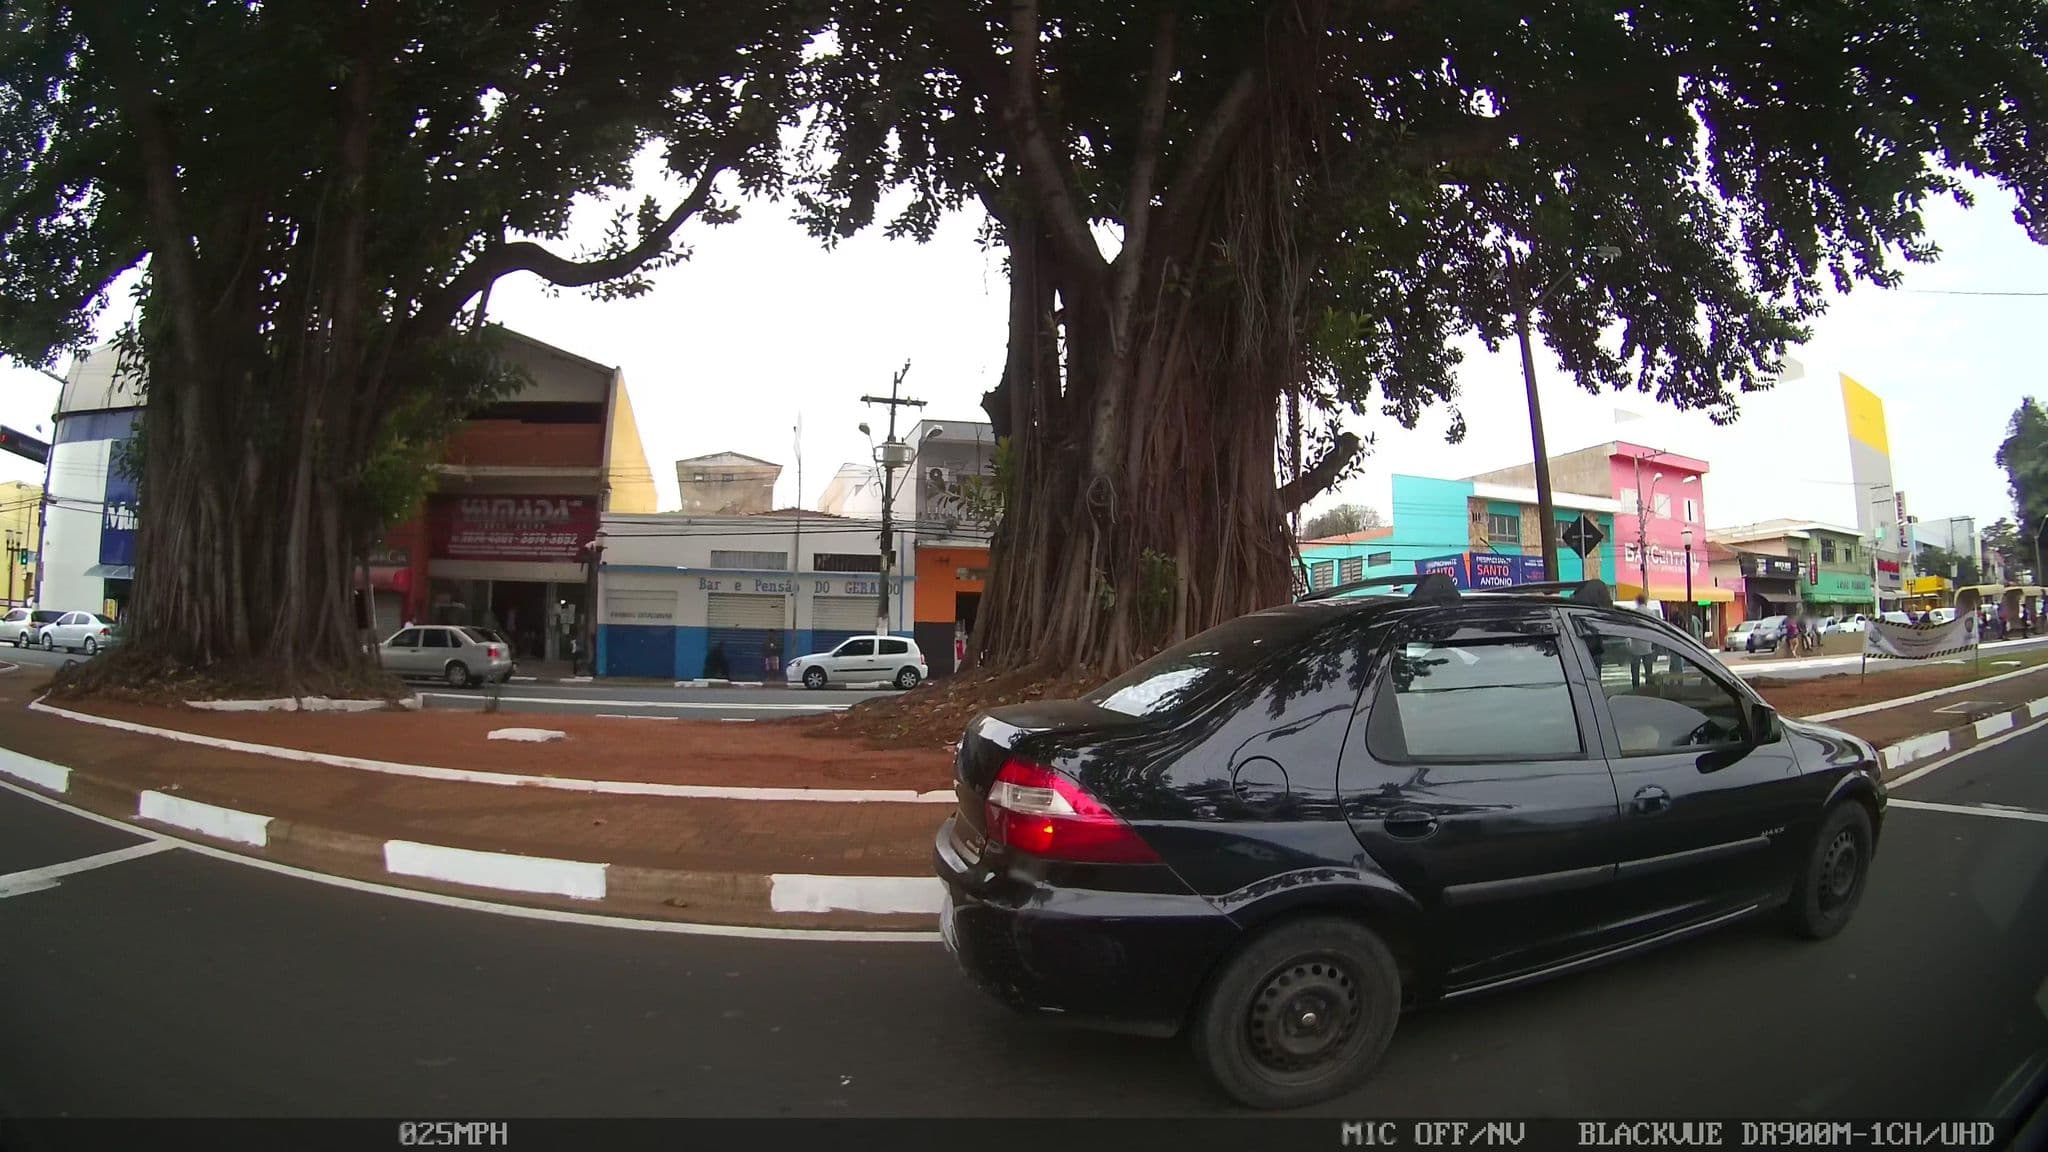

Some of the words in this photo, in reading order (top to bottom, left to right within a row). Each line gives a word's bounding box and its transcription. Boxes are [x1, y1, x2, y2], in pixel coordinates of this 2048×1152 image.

[1477, 564, 1509, 576] SANTO
[699, 577, 721, 590] Bar
[734, 581, 742, 591] e
[754, 578, 800, 593] Pensã
[814, 581, 830, 594] DO
